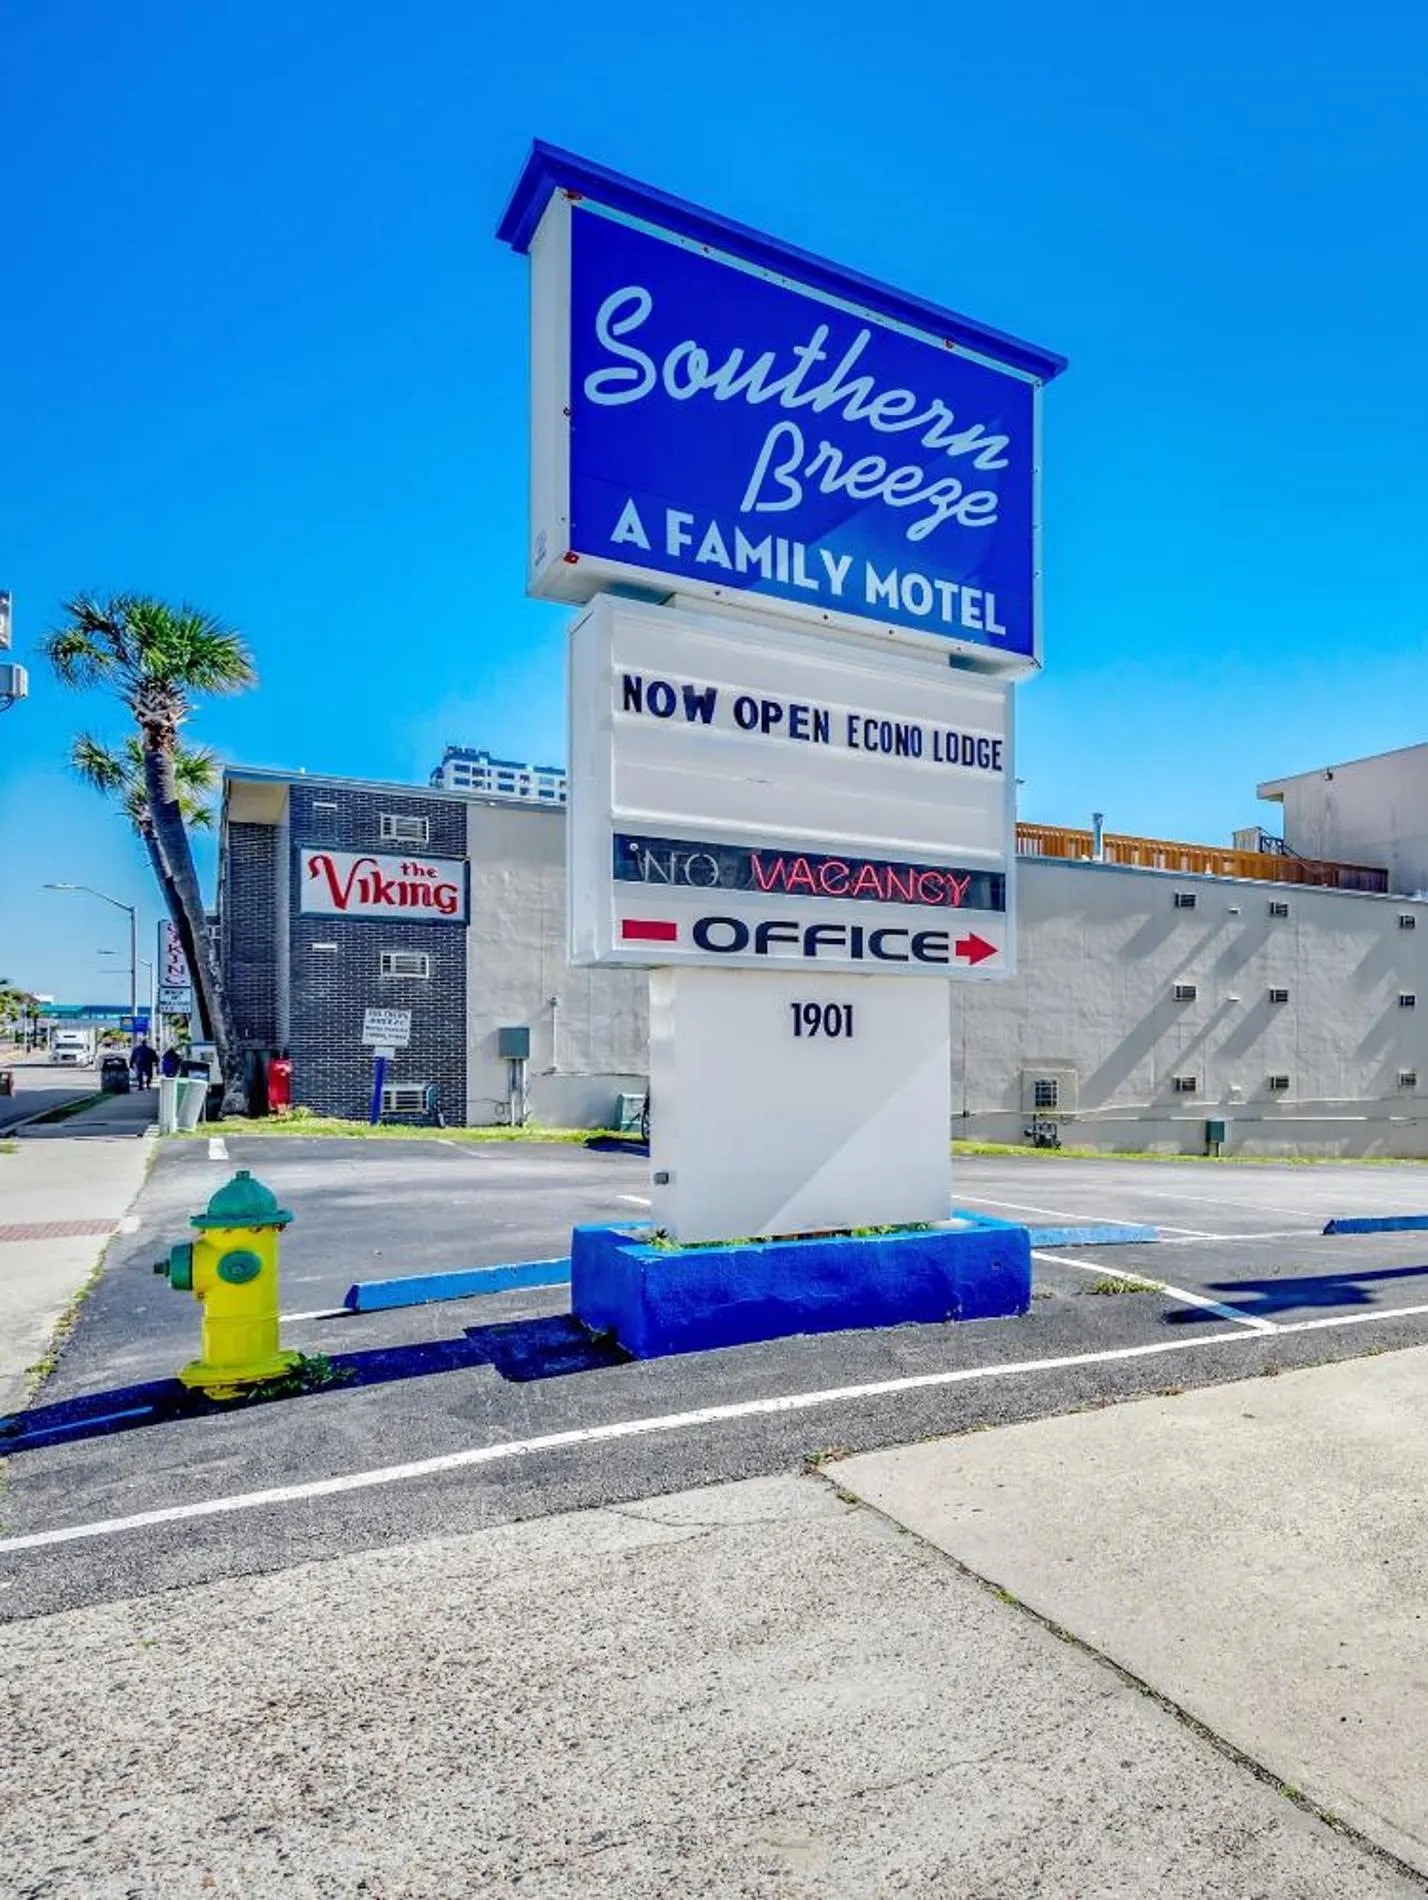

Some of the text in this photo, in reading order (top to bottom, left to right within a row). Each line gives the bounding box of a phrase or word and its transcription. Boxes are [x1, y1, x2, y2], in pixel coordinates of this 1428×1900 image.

[584, 286, 1010, 470] Southern
[740, 420, 999, 541] Breeze
[610, 498, 1007, 636] A FAMILY MOTEL
[622, 674, 1003, 771] NOW OPEN ECONO LODGE
[308, 855, 459, 914] the Viking
[640, 848, 972, 908] NO VACANCY
[692, 916, 949, 964] OFFICE
[790, 1002, 854, 1038] 1901
